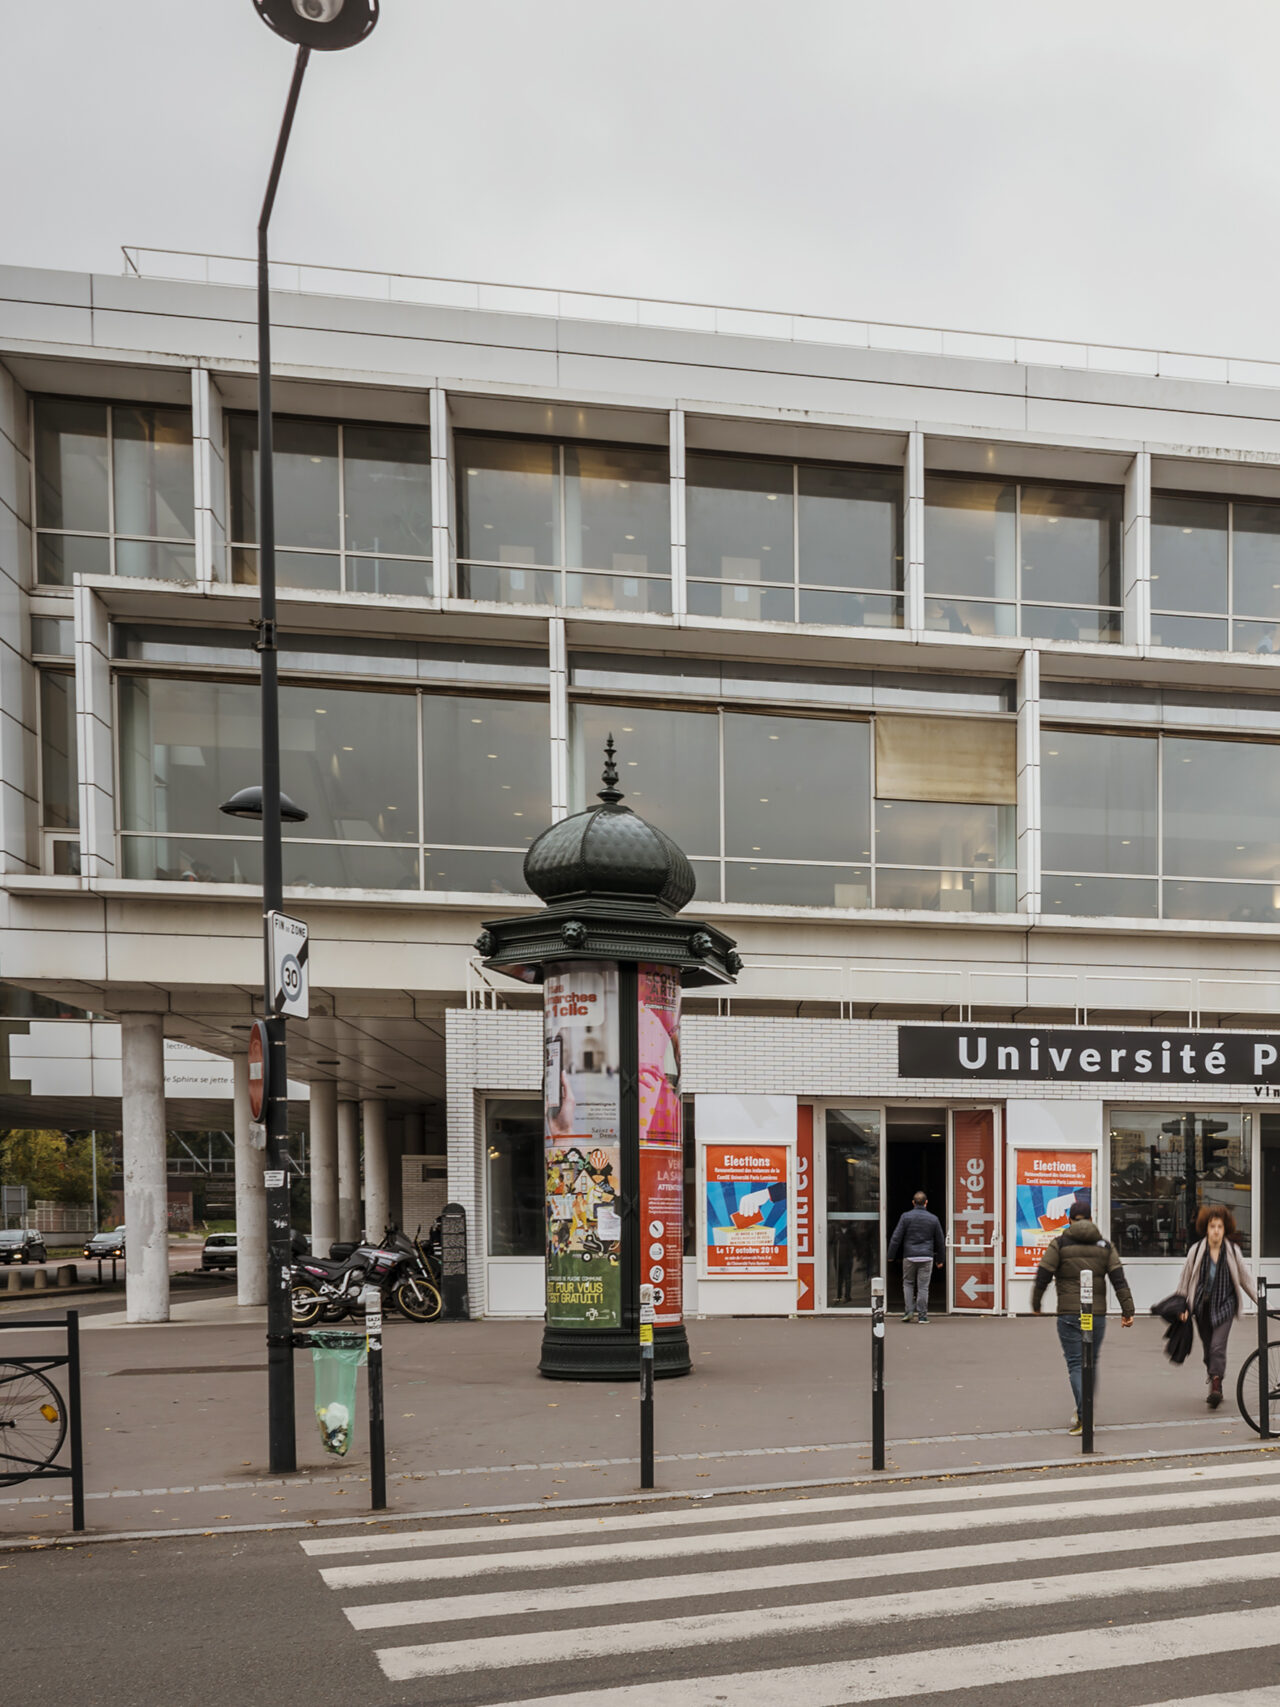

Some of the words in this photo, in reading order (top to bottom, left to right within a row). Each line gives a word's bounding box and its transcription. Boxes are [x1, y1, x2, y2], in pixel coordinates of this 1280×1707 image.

[275, 918, 285, 930] FIN
[291, 924, 306, 938] ZONE
[285, 967, 298, 988] 30
[552, 1004, 558, 1017] 1
[560, 1002, 588, 1016] clic
[957, 1036, 1227, 1076] Université
[172, 1075, 198, 1084] Sphinx
[724, 1155, 770, 1167] Elections
[1033, 1159, 1077, 1172] Elections
[960, 1157, 985, 1252] Entrée
[555, 1282, 574, 1293] POUR
[577, 1282, 603, 1293] VOUS
[561, 1293, 599, 1304] GRATUIT
